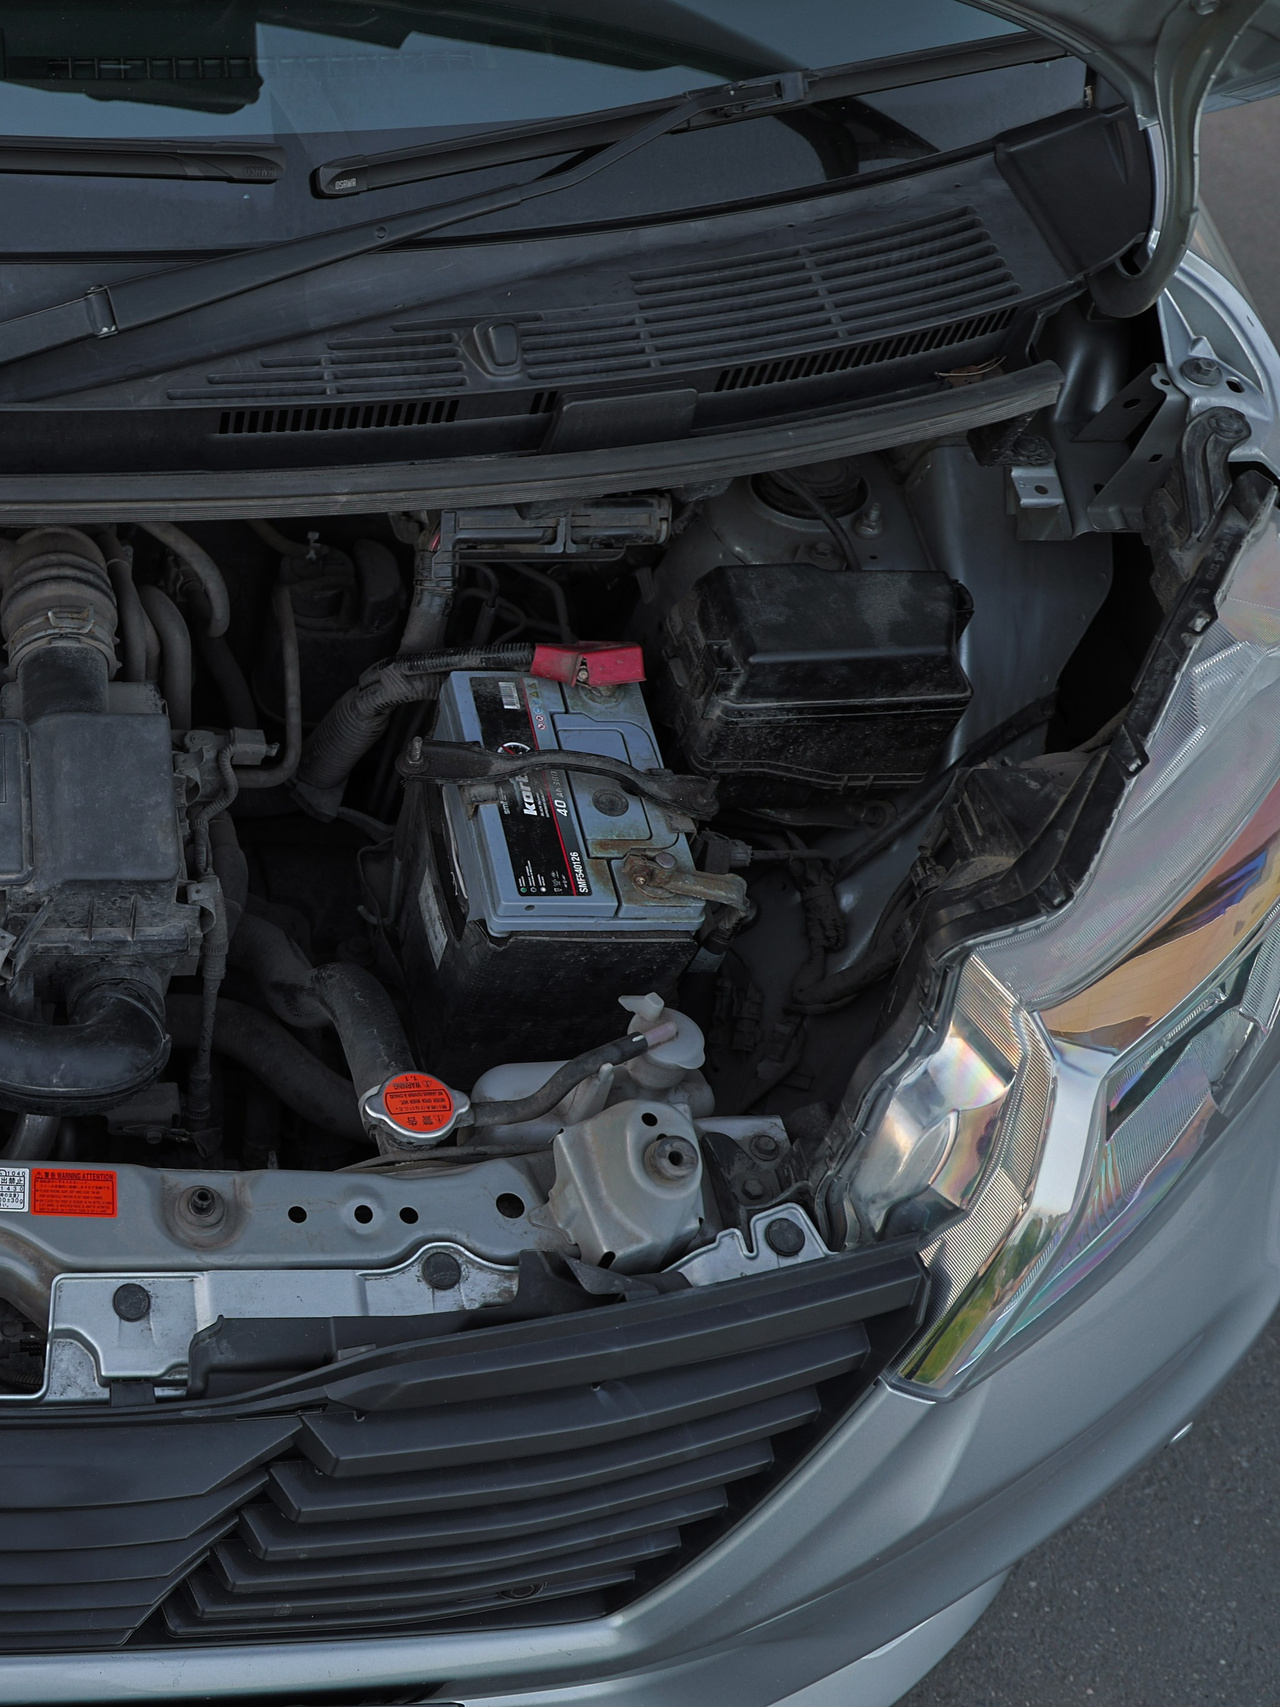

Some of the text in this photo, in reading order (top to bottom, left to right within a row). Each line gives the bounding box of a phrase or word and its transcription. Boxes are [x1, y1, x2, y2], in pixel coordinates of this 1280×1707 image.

[335, 178, 357, 190] OSAWA
[550, 770, 568, 817] 40 Ah 380
[569, 851, 589, 893] SMF540126
[393, 1081, 422, 1090] WARNING
[57, 1172, 81, 1180] WARNING
[82, 1173, 114, 1181] ATTENTION
